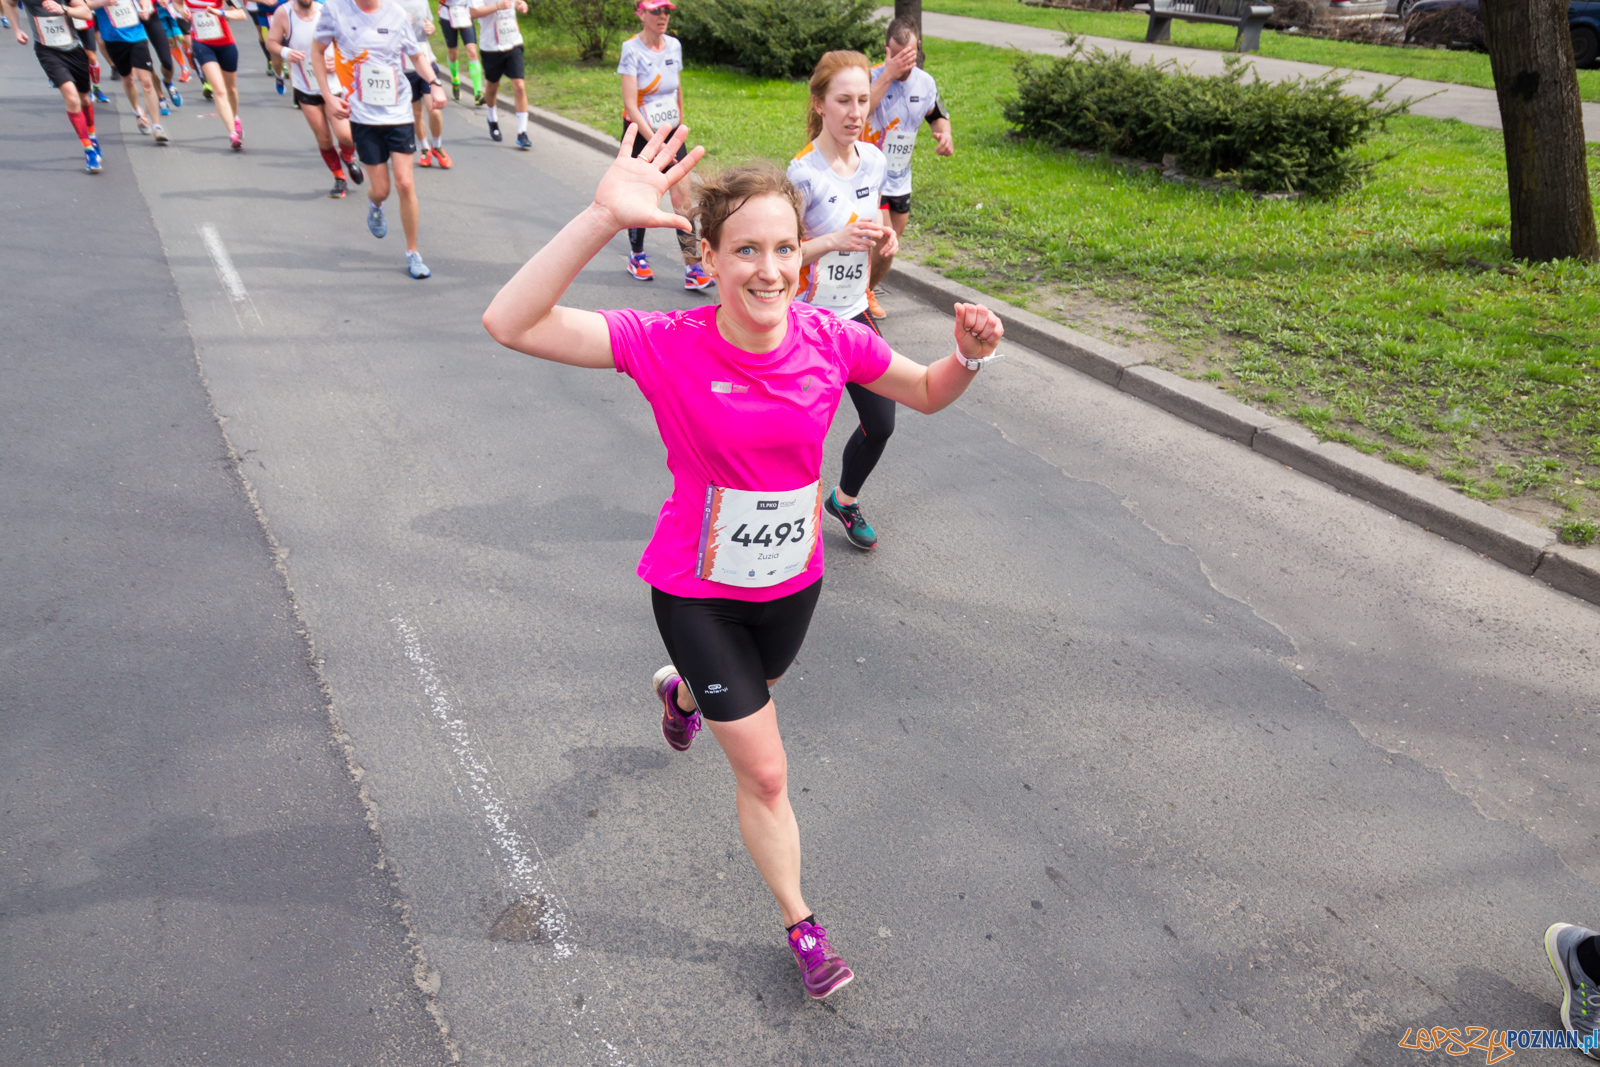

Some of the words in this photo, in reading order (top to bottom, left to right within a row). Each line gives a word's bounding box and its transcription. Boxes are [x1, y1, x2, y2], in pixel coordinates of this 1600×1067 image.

[44, 25, 65, 34] 7675
[367, 78, 391, 89] 9173
[650, 109, 678, 124] 10082
[887, 143, 914, 155] 11983
[827, 264, 863, 281] 1845
[731, 516, 806, 548] 4493
[757, 552, 779, 560] Zuzia
